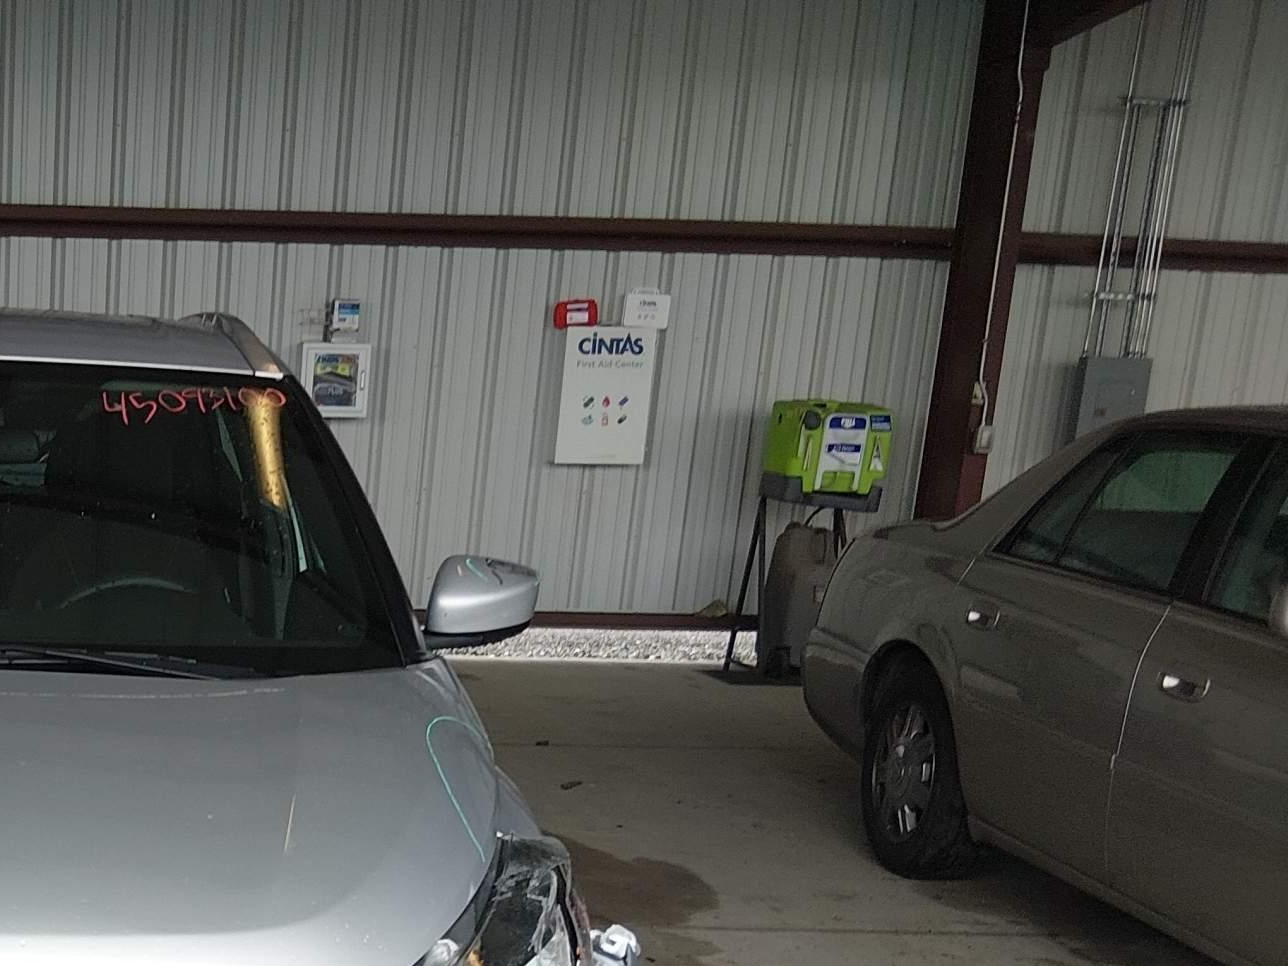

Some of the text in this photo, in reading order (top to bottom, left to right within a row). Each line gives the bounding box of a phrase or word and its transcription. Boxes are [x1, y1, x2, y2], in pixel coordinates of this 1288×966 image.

[578, 331, 644, 356] CINTAS
[576, 359, 645, 369] First Aid Center
